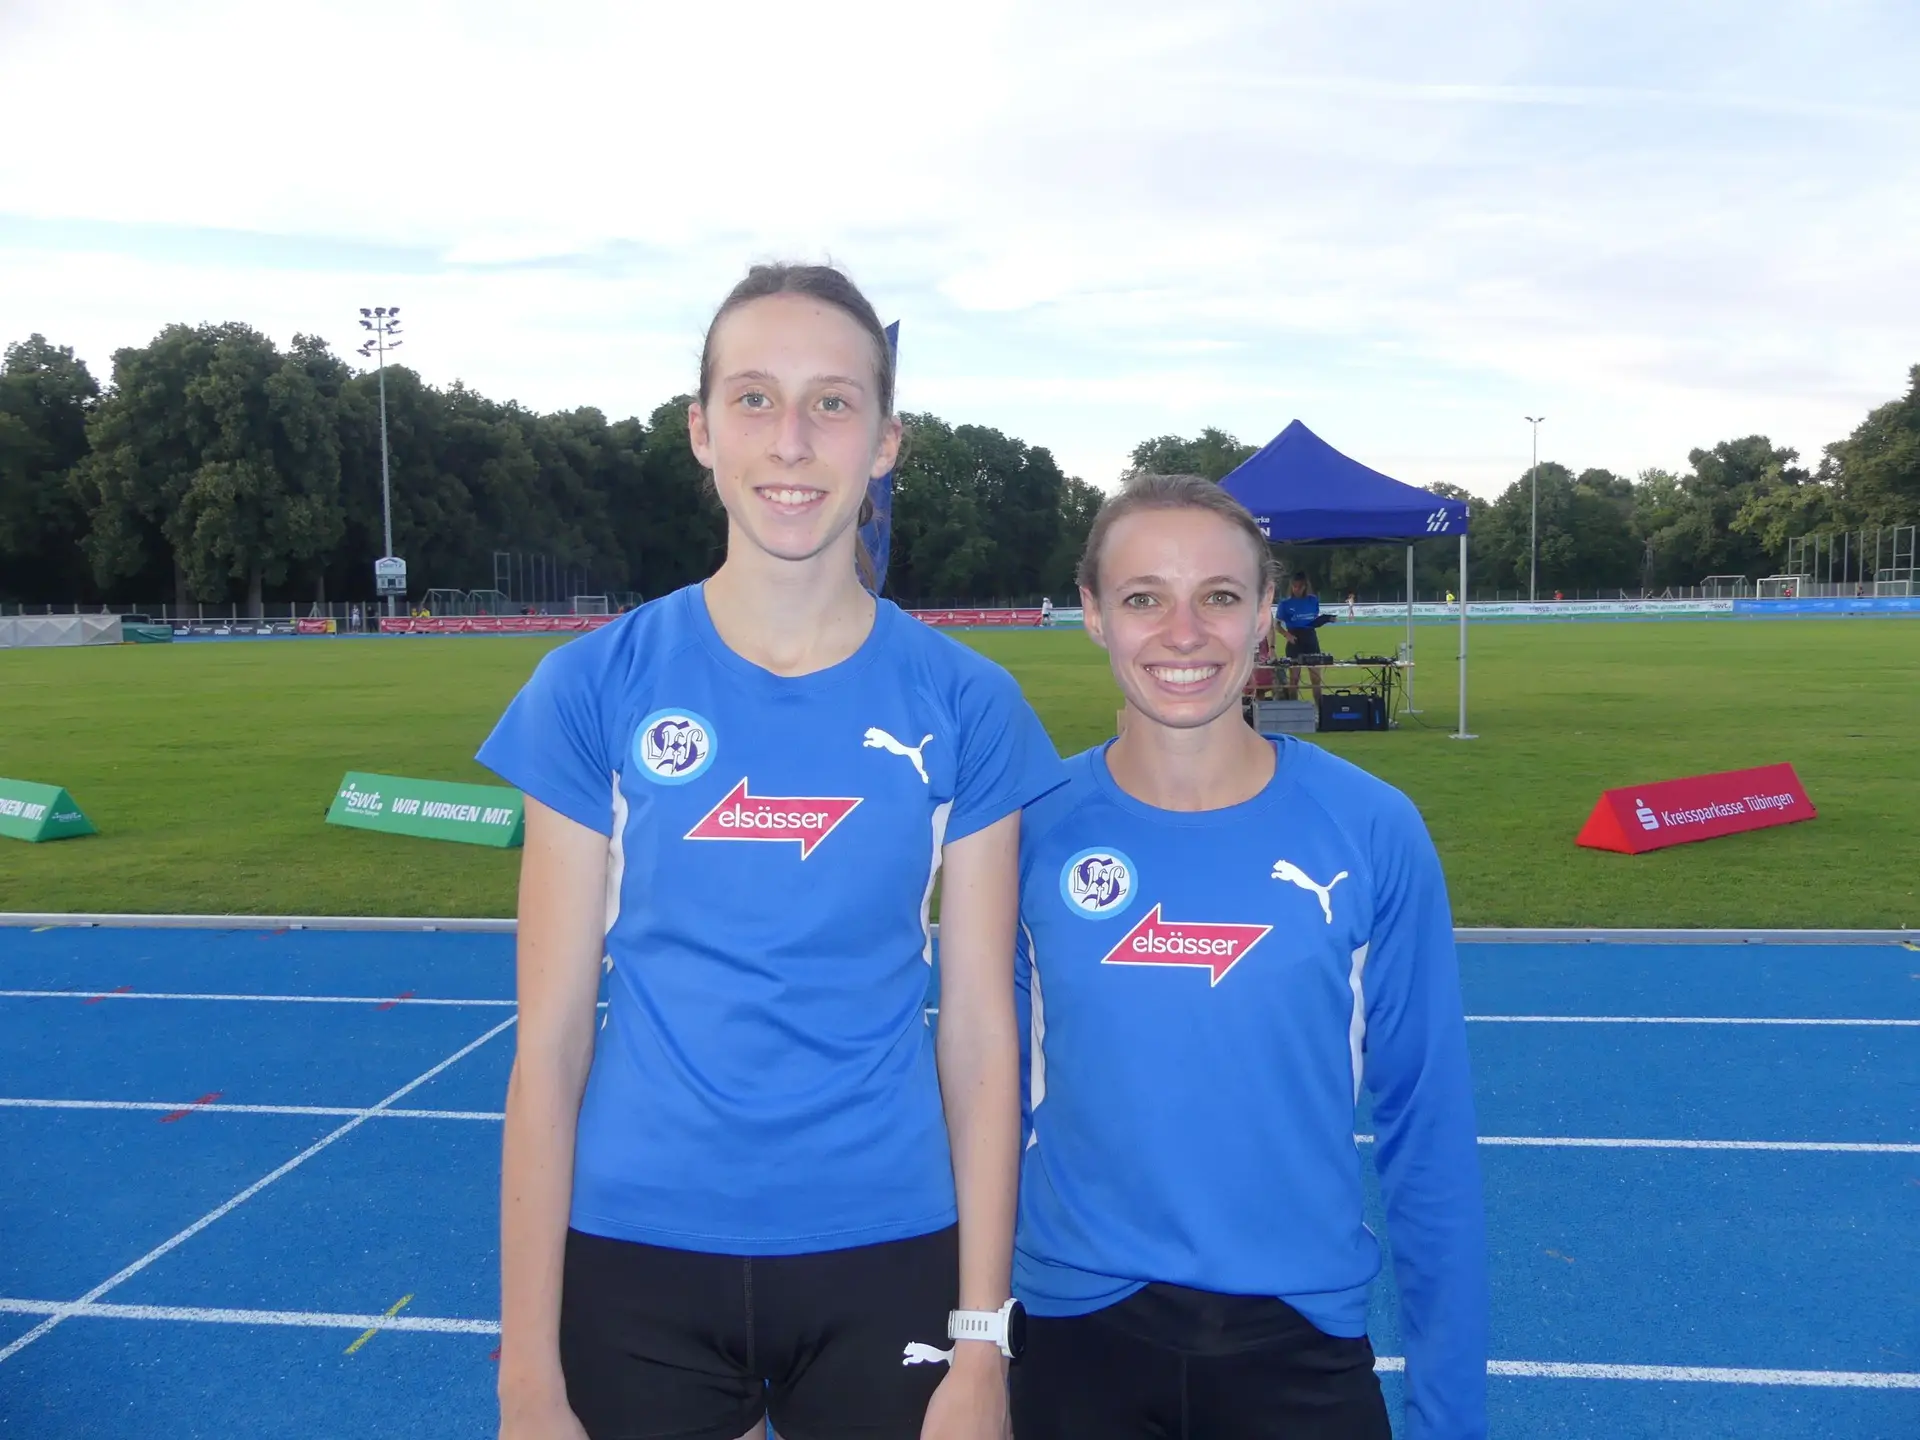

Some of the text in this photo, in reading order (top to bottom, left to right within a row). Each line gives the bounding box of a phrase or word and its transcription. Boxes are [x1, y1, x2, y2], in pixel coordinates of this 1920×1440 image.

[392, 797, 420, 815] WIR
[421, 801, 481, 822] WIRKEN
[718, 803, 828, 829] elsässer
[1661, 792, 1795, 827] Kreissparkasse Tübingen
[1132, 929, 1238, 956] elsässer
